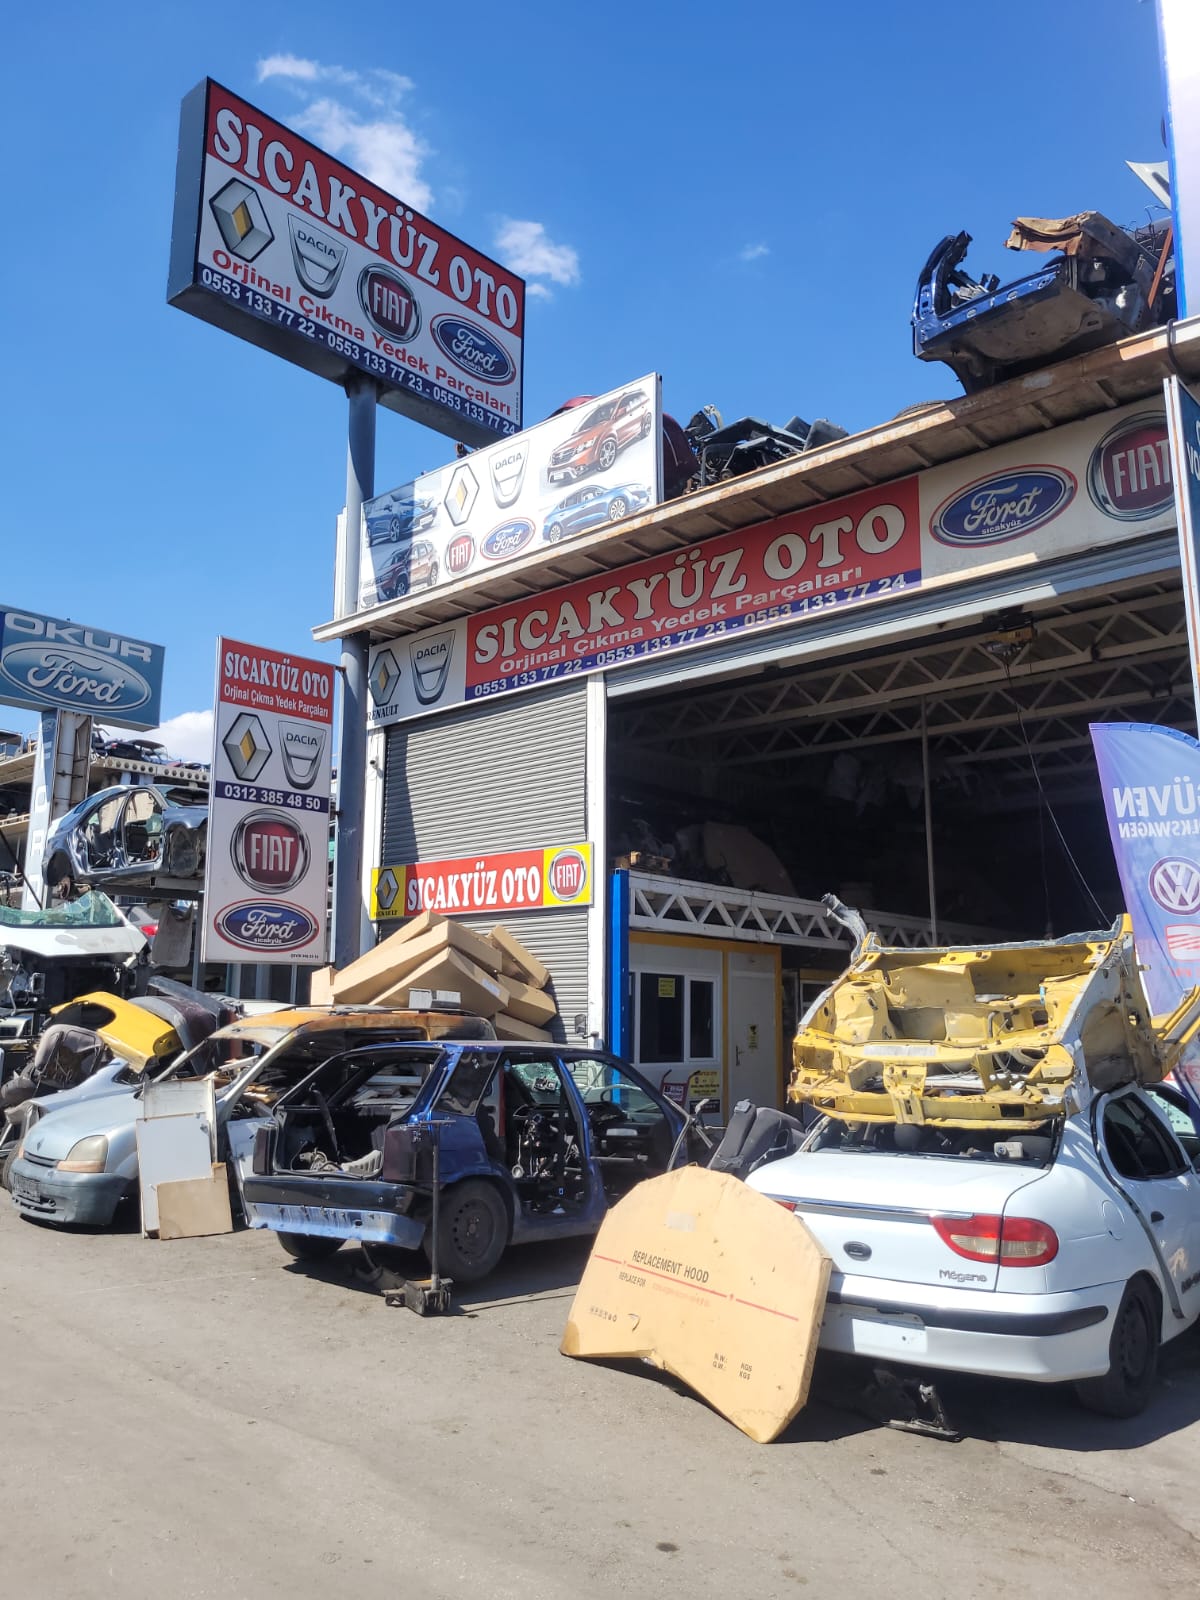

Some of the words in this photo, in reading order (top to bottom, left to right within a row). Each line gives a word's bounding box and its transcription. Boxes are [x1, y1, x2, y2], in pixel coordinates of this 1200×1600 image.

[213, 107, 441, 288] SICAKYÜZ
[448, 254, 518, 330] OTO
[296, 229, 337, 260] DACIA
[373, 282, 408, 328] FIAT
[202, 269, 241, 299] 0553
[246, 291, 272, 315] 133
[277, 305, 295, 326] 77
[297, 318, 316, 338] 22
[327, 332, 360, 360] 0553
[364, 351, 386, 373] 133
[390, 365, 404, 381] 77
[408, 376, 423, 392] 23
[433, 387, 461, 410] 0553
[464, 402, 484, 421] 133
[487, 413, 500, 429] 77
[502, 422, 515, 435] 24
[212, 249, 291, 303] Orjinal
[298, 295, 365, 341] Çıkma
[372, 331, 429, 376] Yedek
[435, 365, 511, 416] Parçaları
[452, 328, 499, 372] Ford
[495, 452, 522, 470] DACIA
[1111, 439, 1171, 497] FIAT
[963, 483, 1043, 532] Ford
[451, 541, 470, 567] FIAT
[493, 527, 523, 552] Ford
[474, 549, 747, 664] SICAKYÜZ
[763, 503, 905, 581] OTO
[4, 612, 152, 663] OKUR
[474, 679, 507, 697] 0553
[512, 671, 537, 687] 133
[542, 664, 560, 680] 77
[564, 659, 583, 675] 22
[597, 649, 635, 666] 0553
[641, 636, 671, 654] 133
[677, 628, 699, 644] 77
[704, 620, 726, 638] 23
[744, 604, 792, 627] 0553
[800, 592, 837, 613] 133
[844, 584, 870, 601] 77
[878, 574, 906, 594] 24
[500, 644, 566, 673] Orjinal
[573, 626, 644, 655] Çıkma
[651, 602, 728, 632] Yedek
[735, 566, 862, 611] Parçaları
[416, 643, 447, 660] DACIA
[27, 653, 125, 703] Ford
[224, 651, 300, 693] SICAKYÜZ
[302, 670, 329, 699] OTO
[224, 684, 249, 701] Orjinal
[251, 690, 274, 705] Çıkma
[275, 695, 297, 711] Yedek
[298, 700, 329, 718] Parçaları
[286, 732, 318, 746] DACIA
[224, 784, 257, 801] 0312
[260, 790, 284, 804] 385
[287, 794, 302, 807] 48
[305, 797, 321, 810] 50
[251, 833, 295, 872] FIAT
[407, 861, 498, 912] SICAKYÜZ
[502, 865, 541, 904] OTO
[556, 863, 579, 889] FIAT
[240, 909, 298, 939] Ford
[619, 1271, 638, 1285] REPLACE
[637, 1277, 647, 1288] FOR
[632, 1250, 683, 1276] REPLACEMENT
[684, 1265, 710, 1284] HOOD
